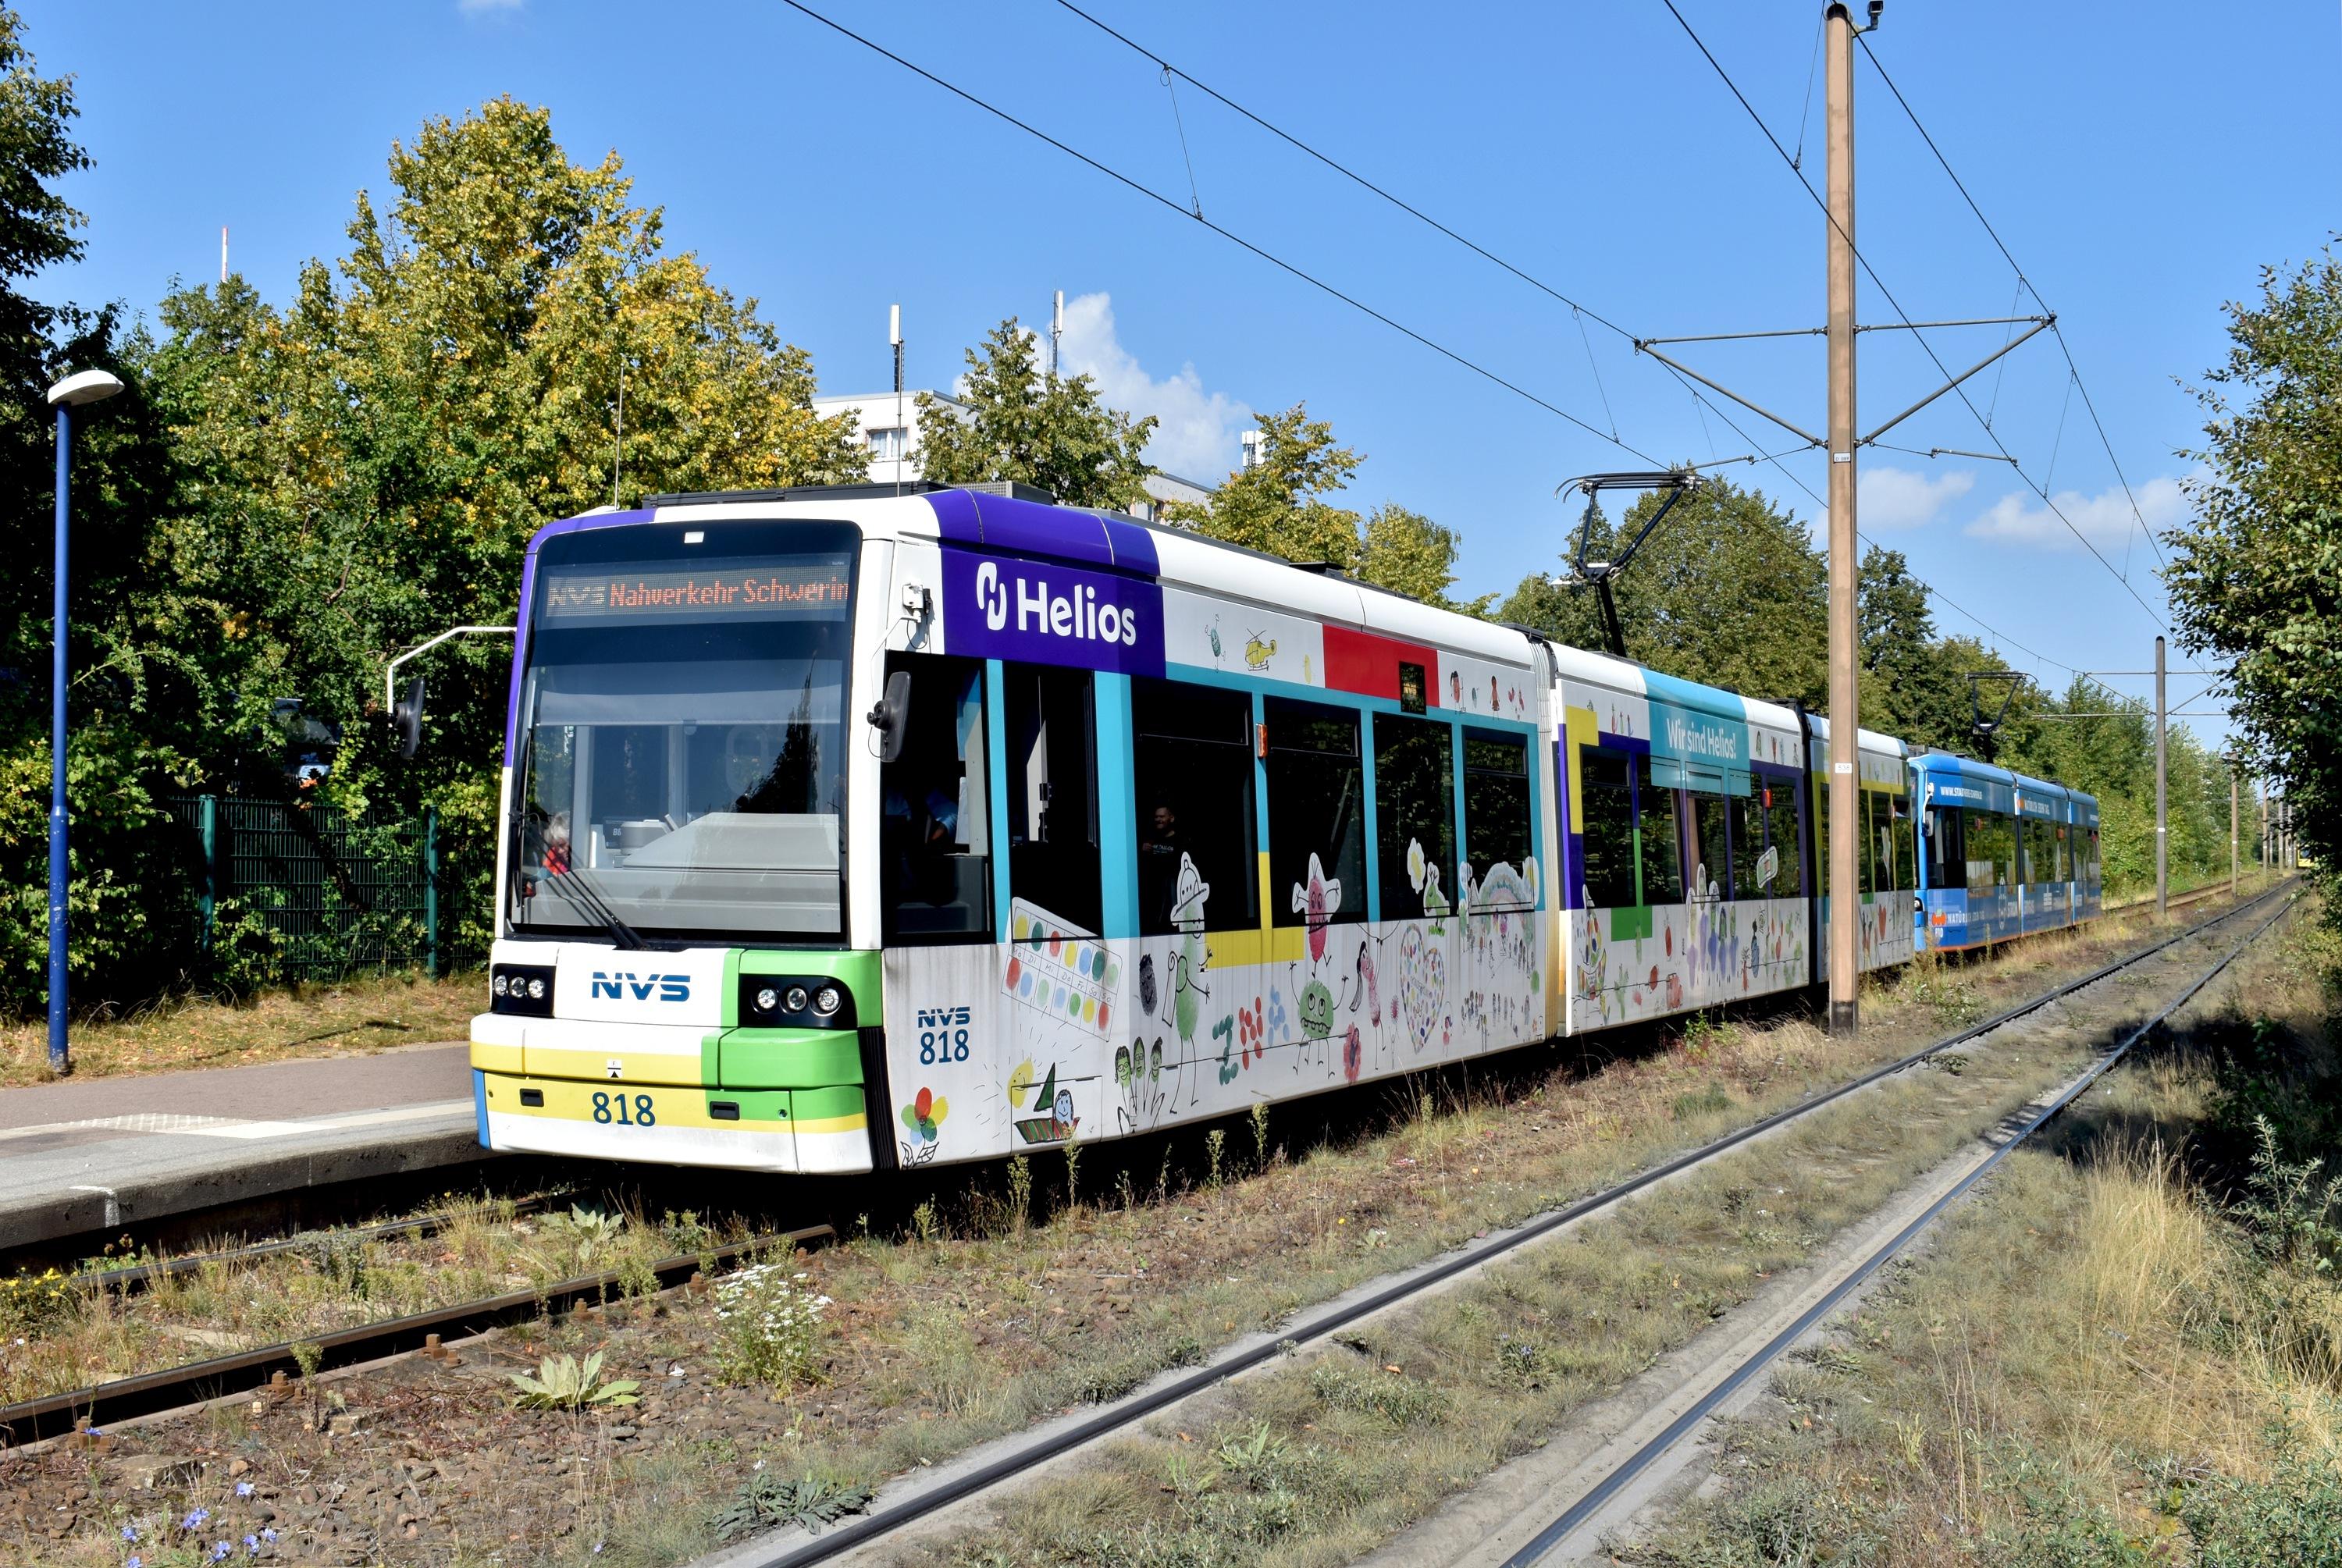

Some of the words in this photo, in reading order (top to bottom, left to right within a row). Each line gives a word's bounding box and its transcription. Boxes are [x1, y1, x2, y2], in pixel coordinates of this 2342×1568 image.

[610, 580, 739, 607] Nahverkehr
[742, 576, 849, 603] Schwerin
[1016, 578, 1137, 645] Helios
[1667, 718, 1686, 750] Wir
[1687, 722, 1706, 754] sind
[1707, 727, 1736, 759] Helios!
[592, 972, 691, 1002] NVS
[918, 1007, 970, 1028] NVS
[920, 1029, 970, 1065] 818
[592, 1092, 656, 1127] 818
